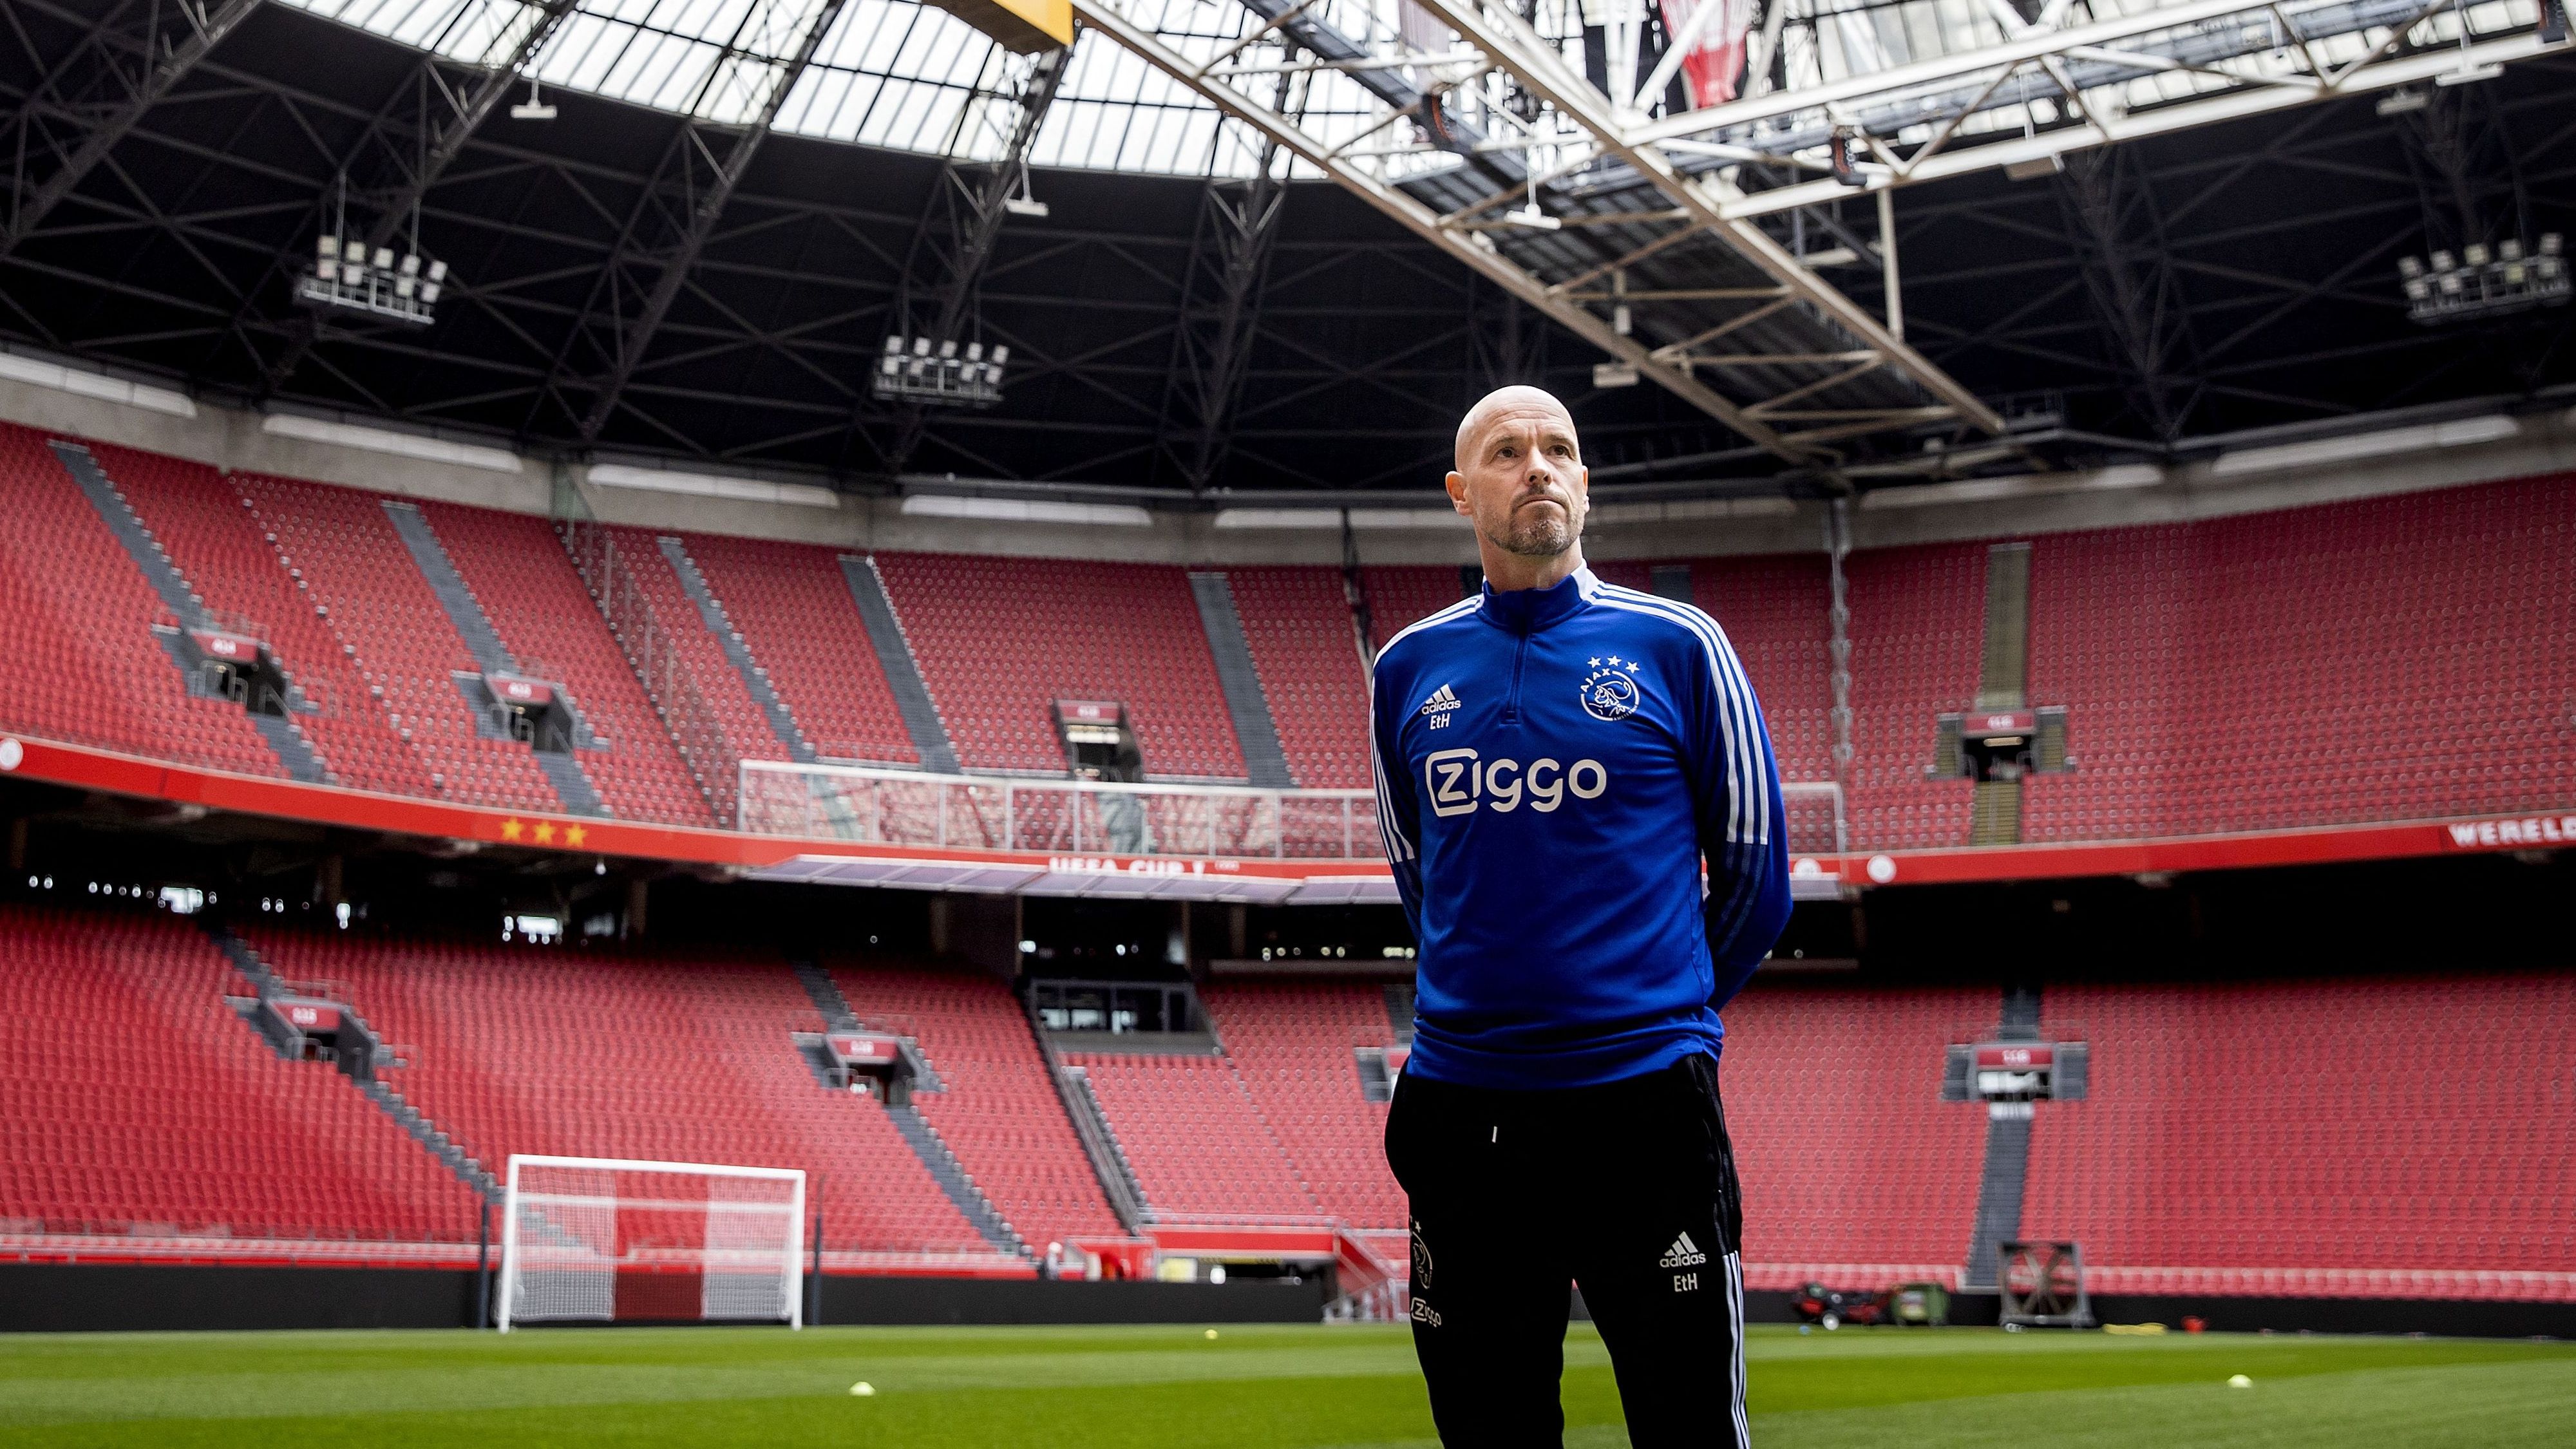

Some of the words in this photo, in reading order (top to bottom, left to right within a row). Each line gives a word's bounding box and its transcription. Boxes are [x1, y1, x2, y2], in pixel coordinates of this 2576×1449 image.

[1580, 668, 1611, 693] AJAX
[1421, 700, 1461, 715] adidas
[1430, 713, 1450, 730] EtH
[1049, 857, 1119, 872] UEFA
[1128, 859, 1185, 876] CUP
[1660, 1253, 1707, 1267] adidas
[1674, 1273, 1698, 1292] EtH
